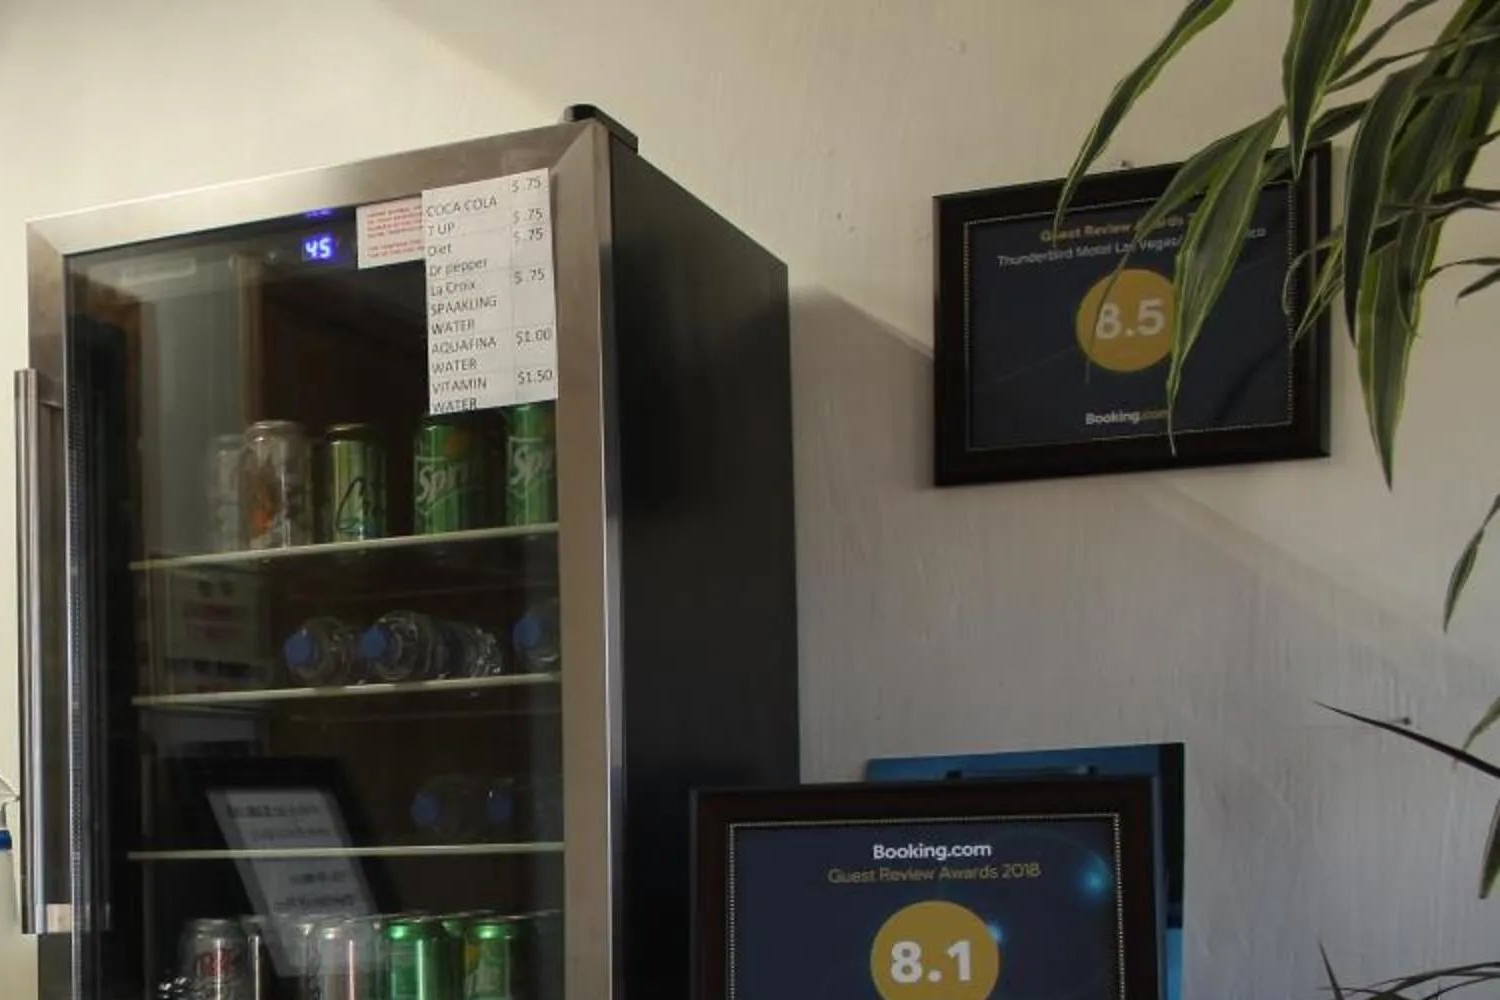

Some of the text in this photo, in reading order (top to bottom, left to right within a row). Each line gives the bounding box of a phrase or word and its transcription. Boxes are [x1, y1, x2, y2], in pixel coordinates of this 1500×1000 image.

[426, 195, 498, 217] COCA COLA
[304, 236, 332, 259] 45
[427, 244, 453, 257] Diet
[997, 247, 1074, 267] Thunderbird
[431, 319, 475, 335] WATER
[1096, 299, 1166, 339] 8.5
[431, 336, 497, 353] AQUAFINA
[515, 328, 553, 345] $1.00
[431, 358, 477, 374] WATER
[431, 377, 487, 394] VITAMIN
[517, 369, 553, 385] $1.50
[431, 398, 478, 413] WATER
[873, 842, 992, 861] Booking.com
[828, 862, 1042, 884] Guest Review Awards 2018
[890, 940, 973, 984] 8.1
